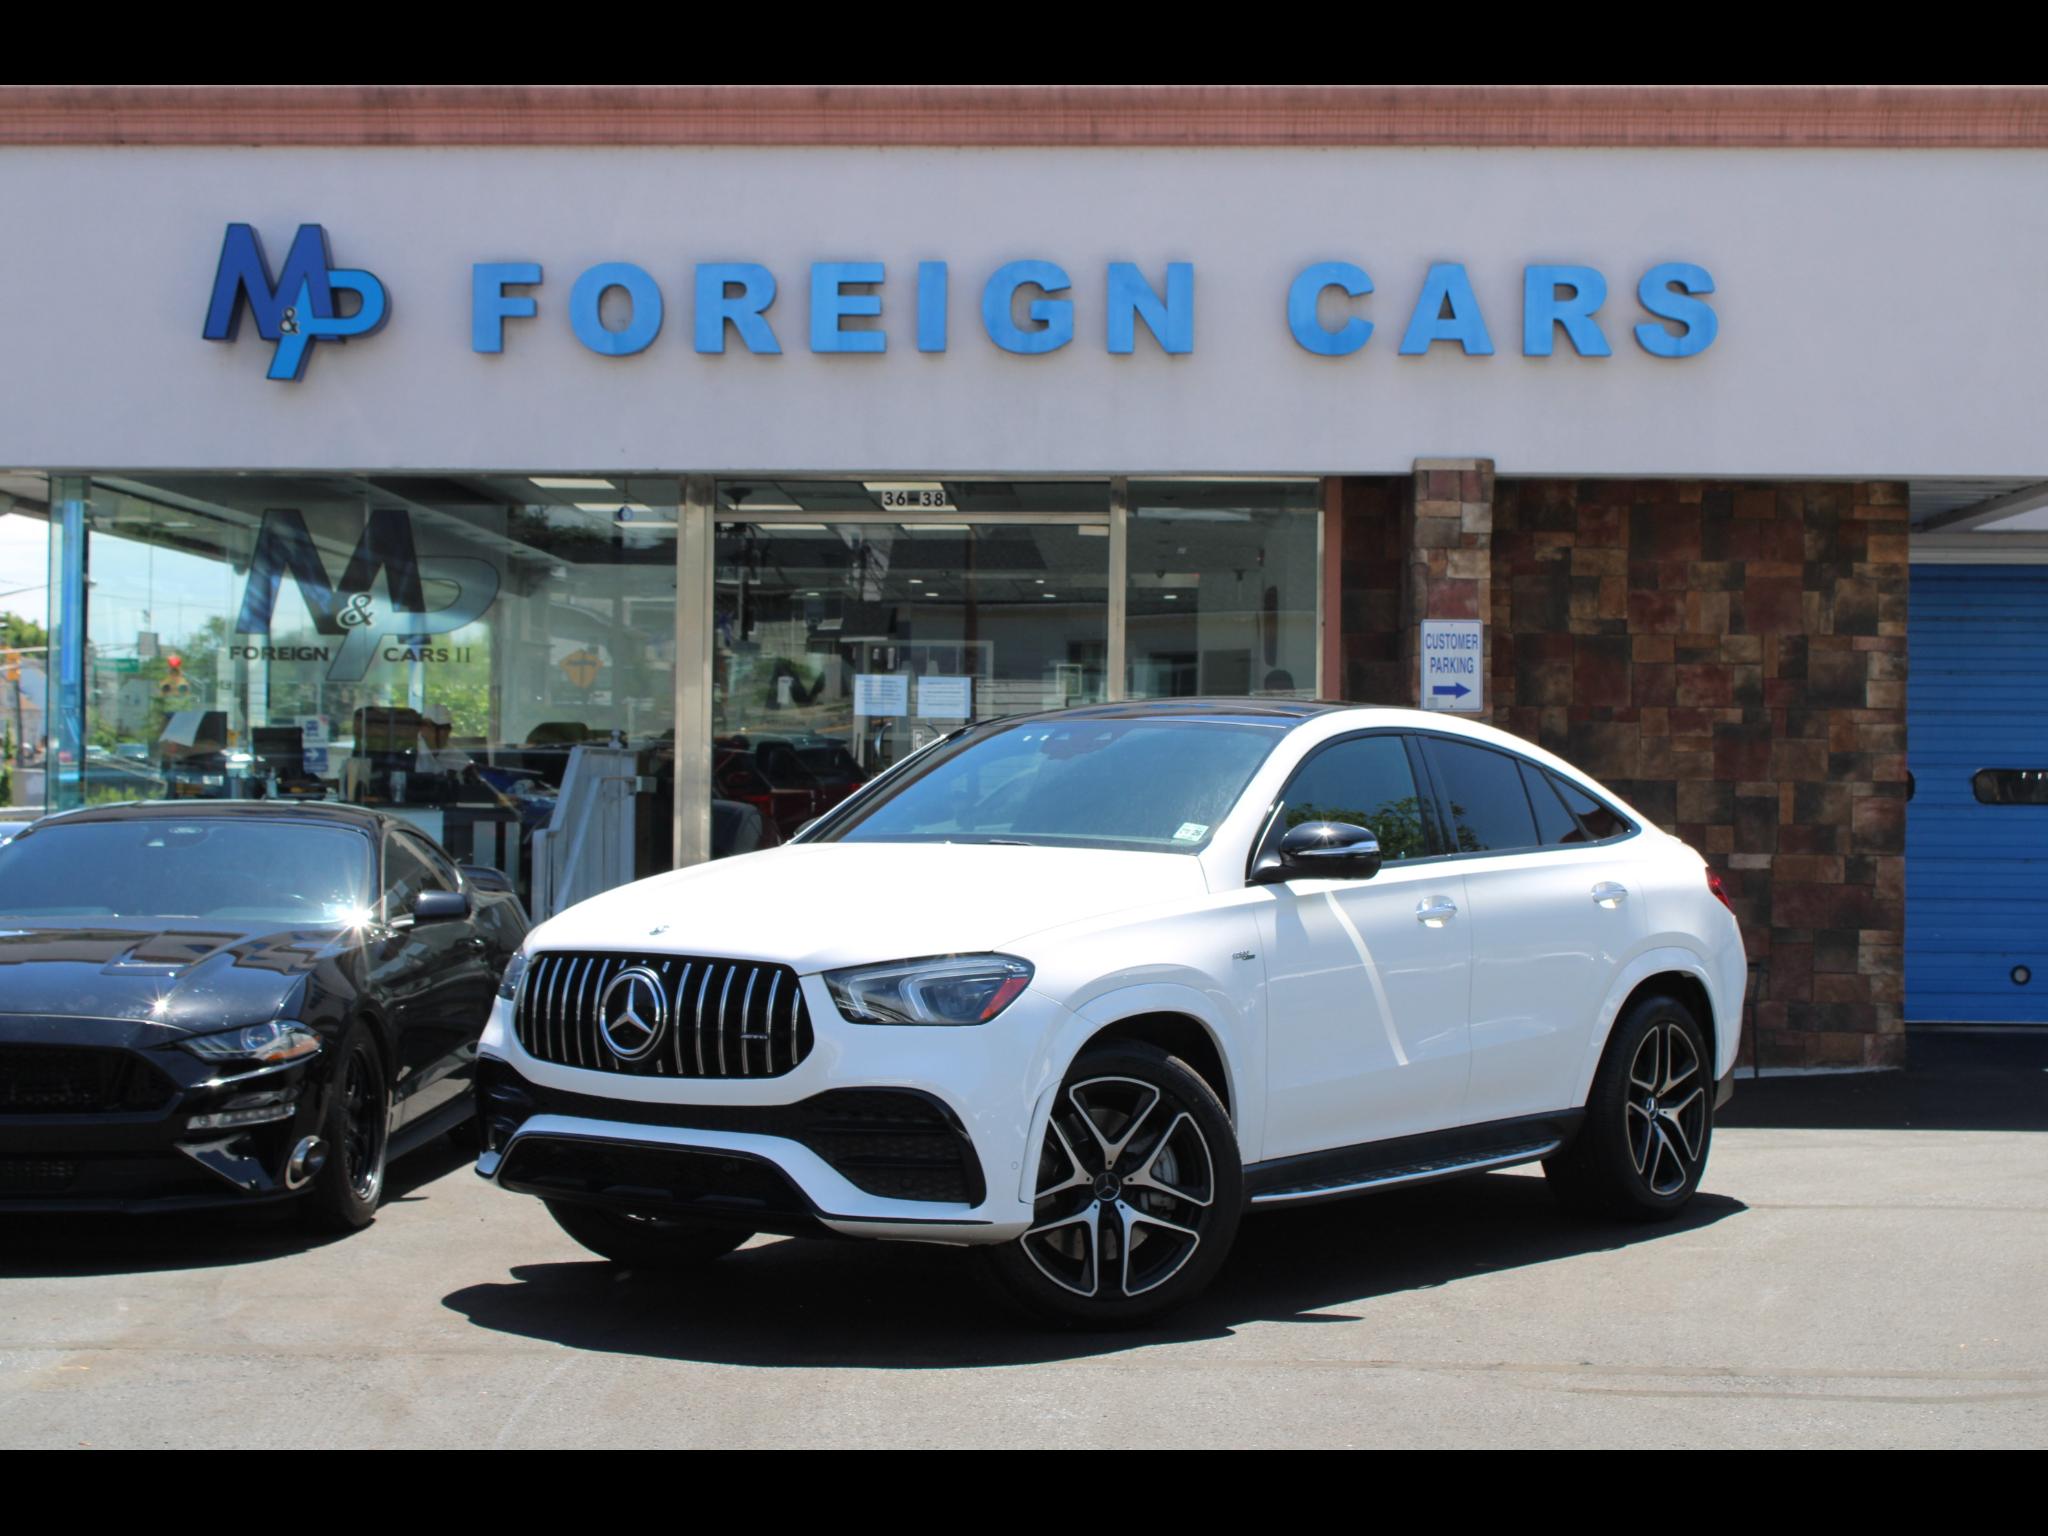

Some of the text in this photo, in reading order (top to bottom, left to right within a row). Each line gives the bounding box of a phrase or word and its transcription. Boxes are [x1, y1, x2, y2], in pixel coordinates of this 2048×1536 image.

[472, 259, 1194, 357] FOREIGN
[1287, 259, 1720, 357] CARS
[1425, 633, 1479, 650] CUSTOMER
[229, 646, 329, 662] FOREIGN
[383, 647, 449, 663] CARS
[1430, 656, 1474, 674] PARKING
